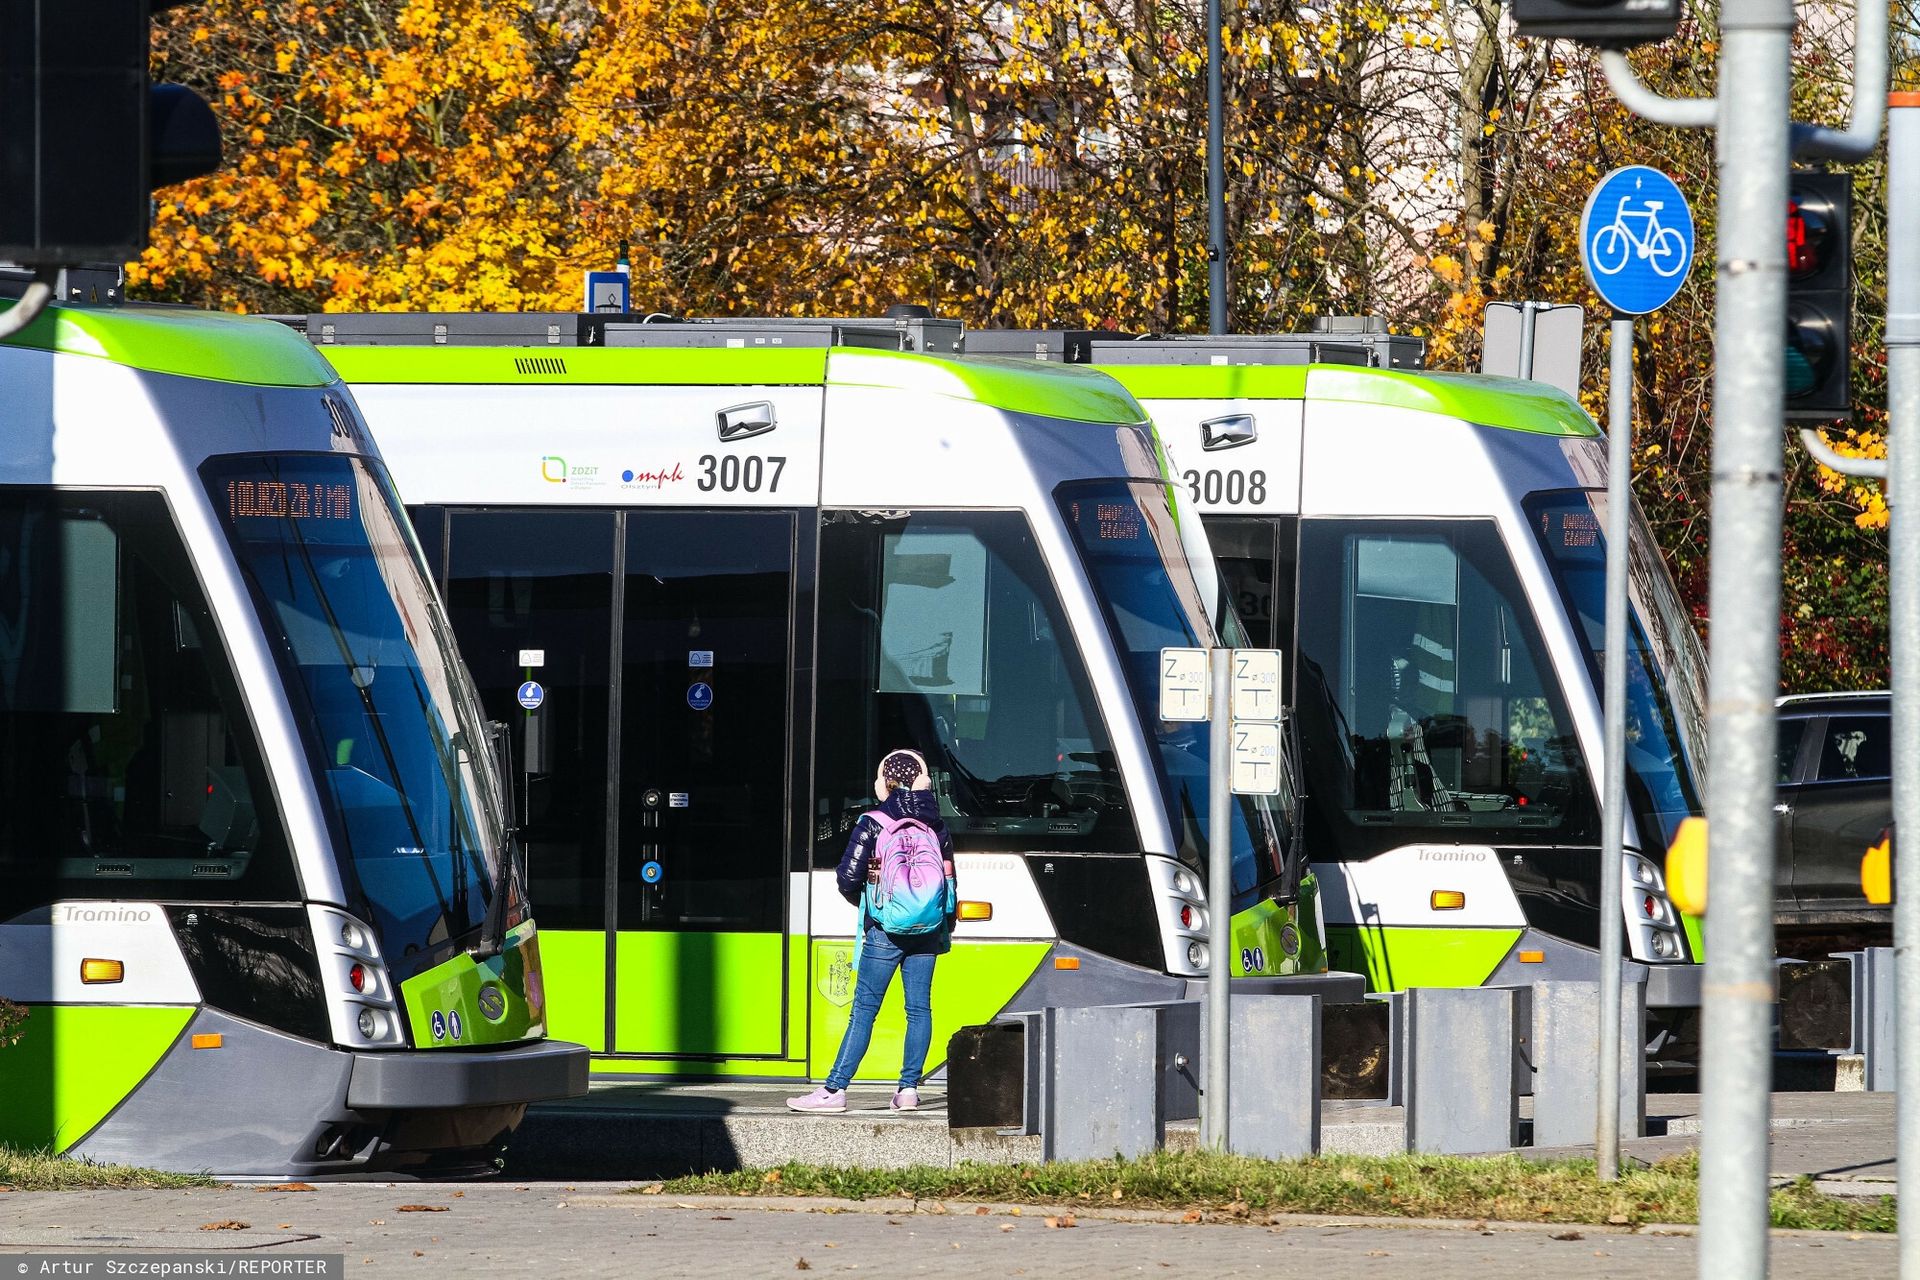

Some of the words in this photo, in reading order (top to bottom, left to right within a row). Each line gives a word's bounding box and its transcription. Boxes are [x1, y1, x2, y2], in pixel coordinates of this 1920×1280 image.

[571, 466, 599, 475] ZDZiT
[636, 462, 685, 489] mpk
[697, 454, 787, 493] 3007
[1183, 469, 1267, 505] 3008
[1164, 658, 1177, 678] Z
[1236, 659, 1249, 679] Z
[1260, 672, 1276, 684] 300
[1236, 731, 1249, 752] Z
[1417, 848, 1487, 862] Tramino
[63, 905, 151, 923] Tramino
